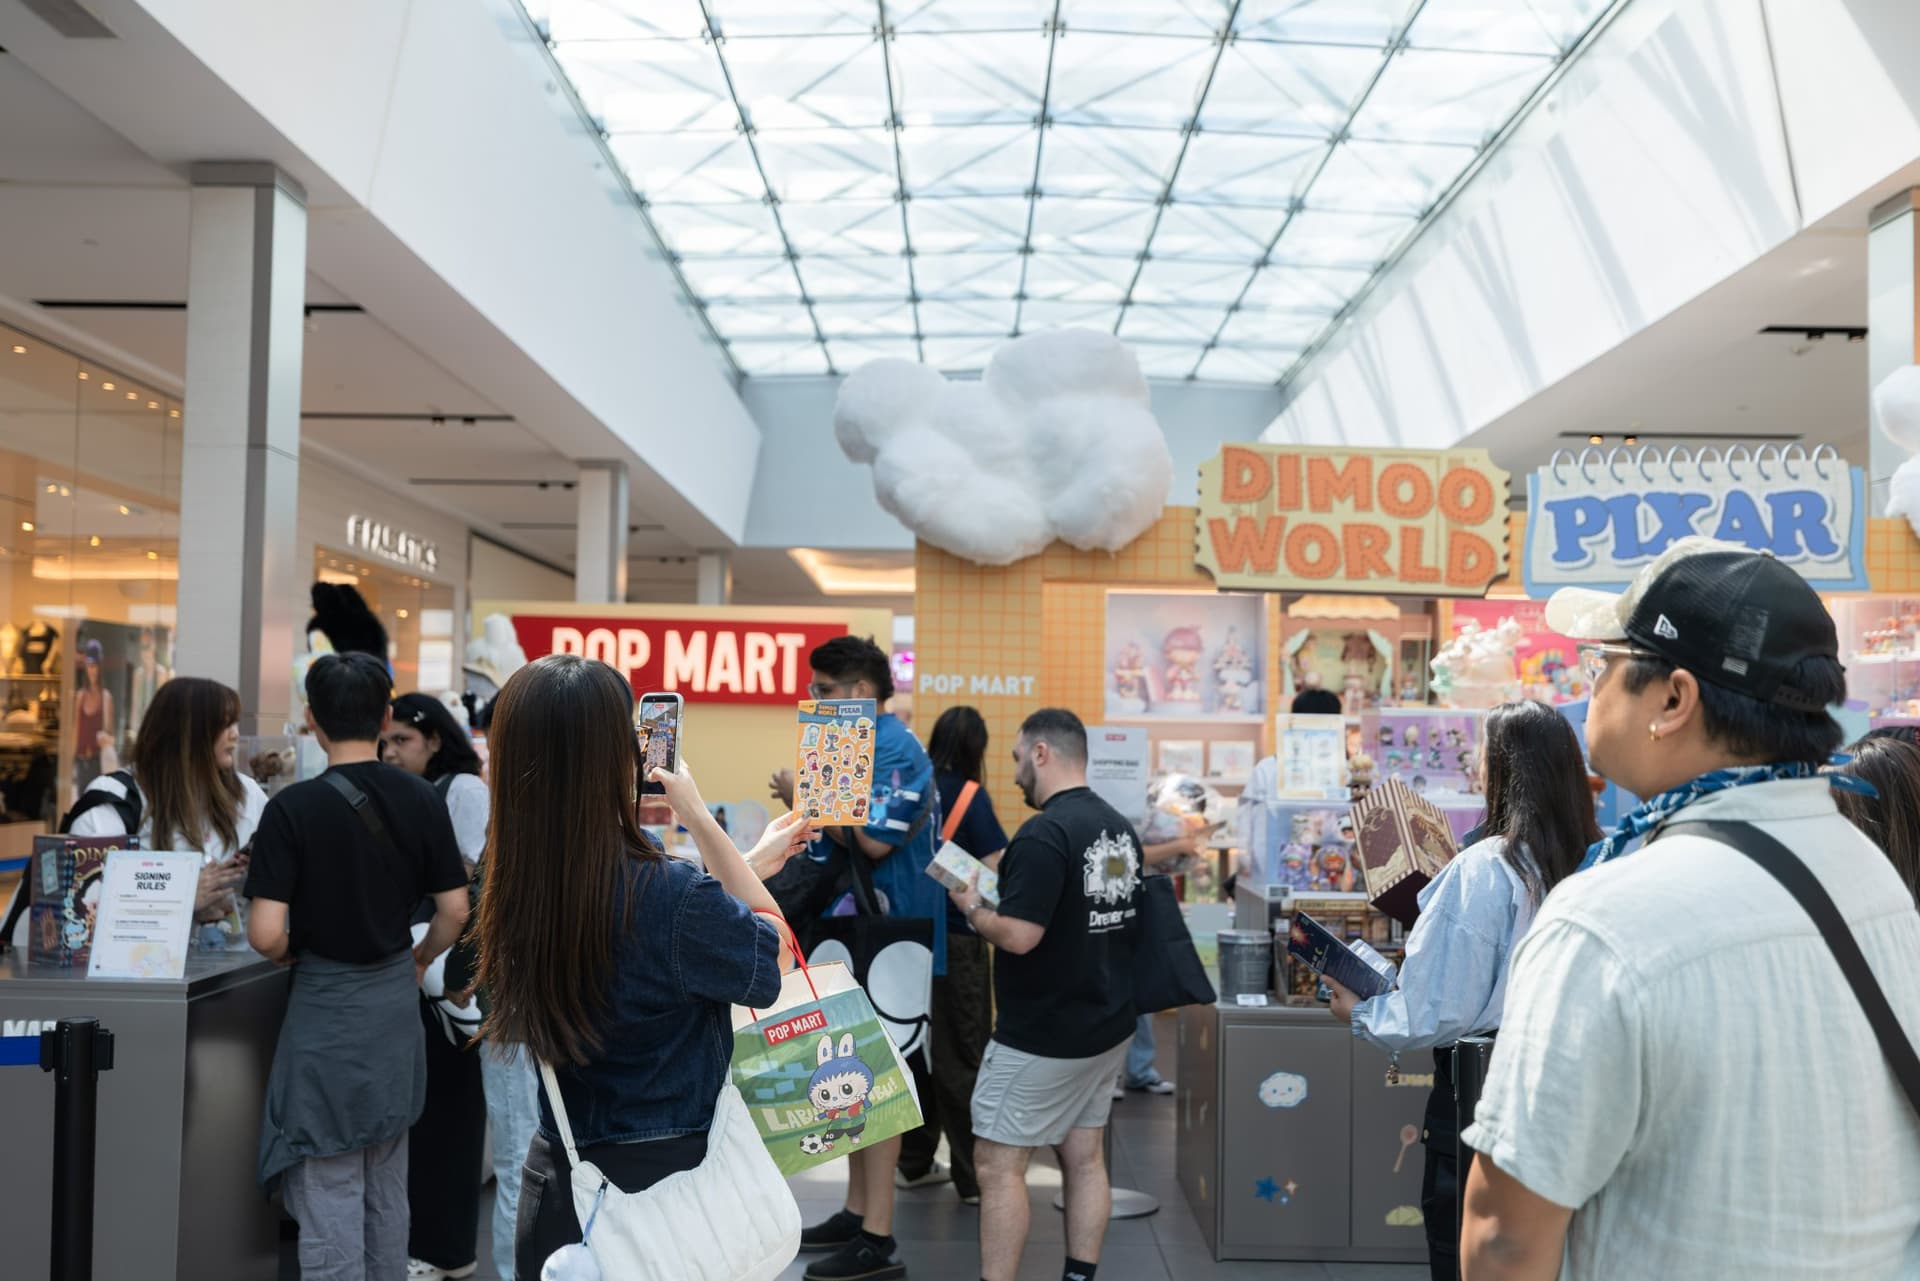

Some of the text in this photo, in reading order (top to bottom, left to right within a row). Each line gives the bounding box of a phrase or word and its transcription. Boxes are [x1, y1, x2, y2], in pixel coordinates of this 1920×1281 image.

[1221, 445, 1495, 526] DIMOO
[1544, 490, 1840, 562] PIXAR
[1207, 515, 1498, 588] WORLD
[663, 630, 806, 694] MART
[919, 673, 1035, 696] POP MART
[134, 872, 171, 881] SIGNING
[136, 882, 167, 890] RULES
[767, 1012, 824, 1043] POP MART
